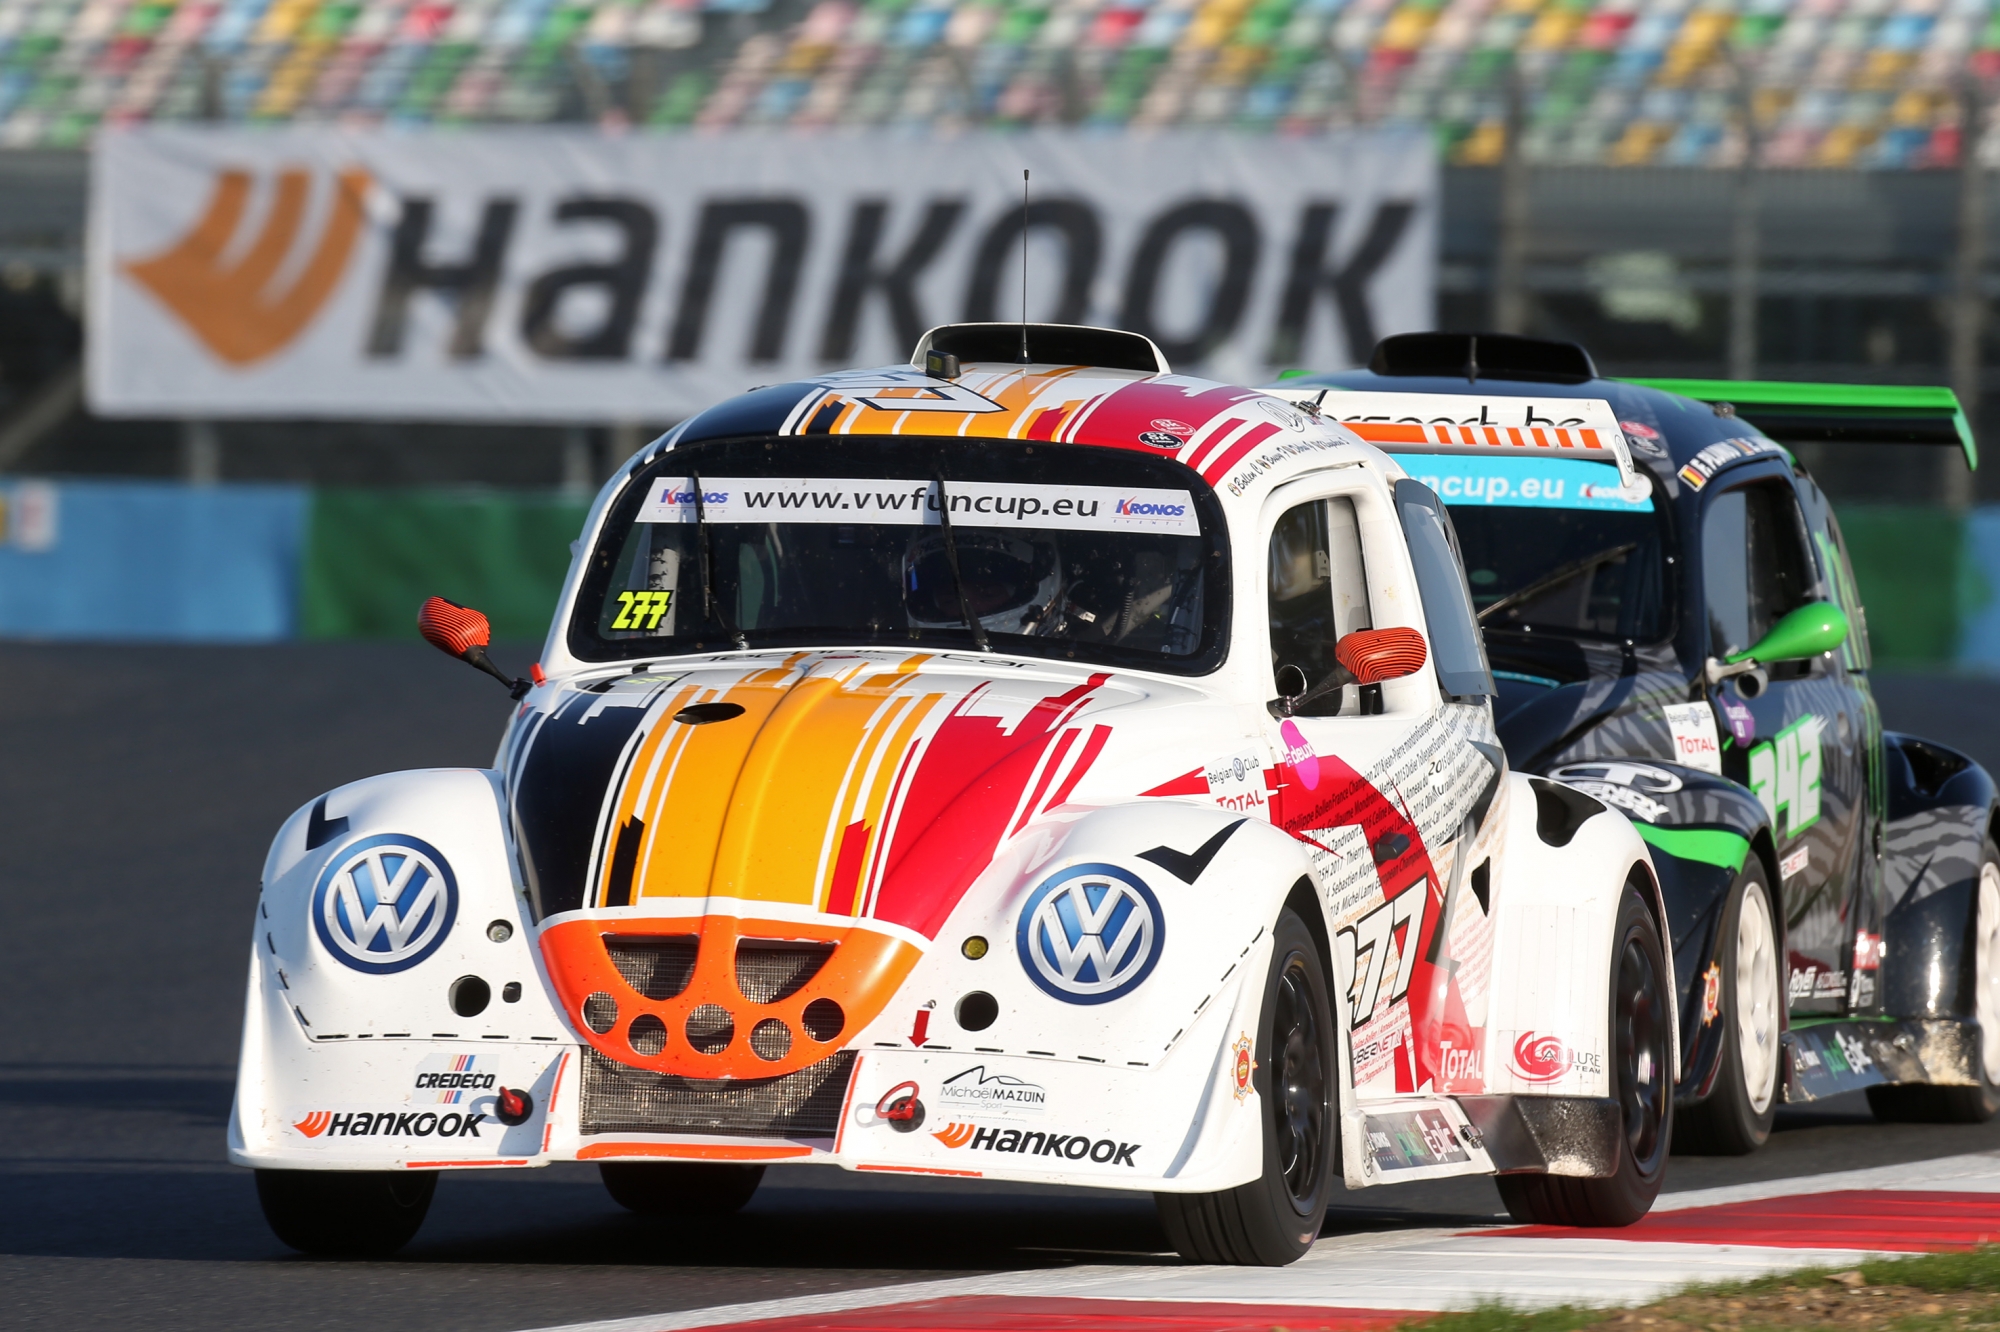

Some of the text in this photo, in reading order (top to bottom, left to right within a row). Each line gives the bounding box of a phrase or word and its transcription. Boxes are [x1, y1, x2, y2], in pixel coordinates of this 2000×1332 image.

[1412, 475, 1564, 503] ncup.eu
[744, 487, 1098, 520] www.vwfuncup.eu
[1115, 495, 1185, 516] KRONOS
[610, 591, 671, 630] 277
[1677, 735, 1716, 754] TOTAL
[1208, 767, 1234, 785] Belgian
[1243, 756, 1260, 772] Club
[1216, 789, 1264, 812] TOTAL
[1331, 824, 1359, 852] Zandvoort
[1346, 843, 1365, 865] Thierry
[1331, 870, 1358, 897] Sebastien
[1340, 888, 1359, 914] Michel
[1360, 880, 1375, 901] Lamy
[1439, 1040, 1483, 1080] TOTAL
[1574, 1064, 1601, 1075] TEAM
[415, 1073, 495, 1089] CREDECO
[979, 1100, 1004, 1111] Sport
